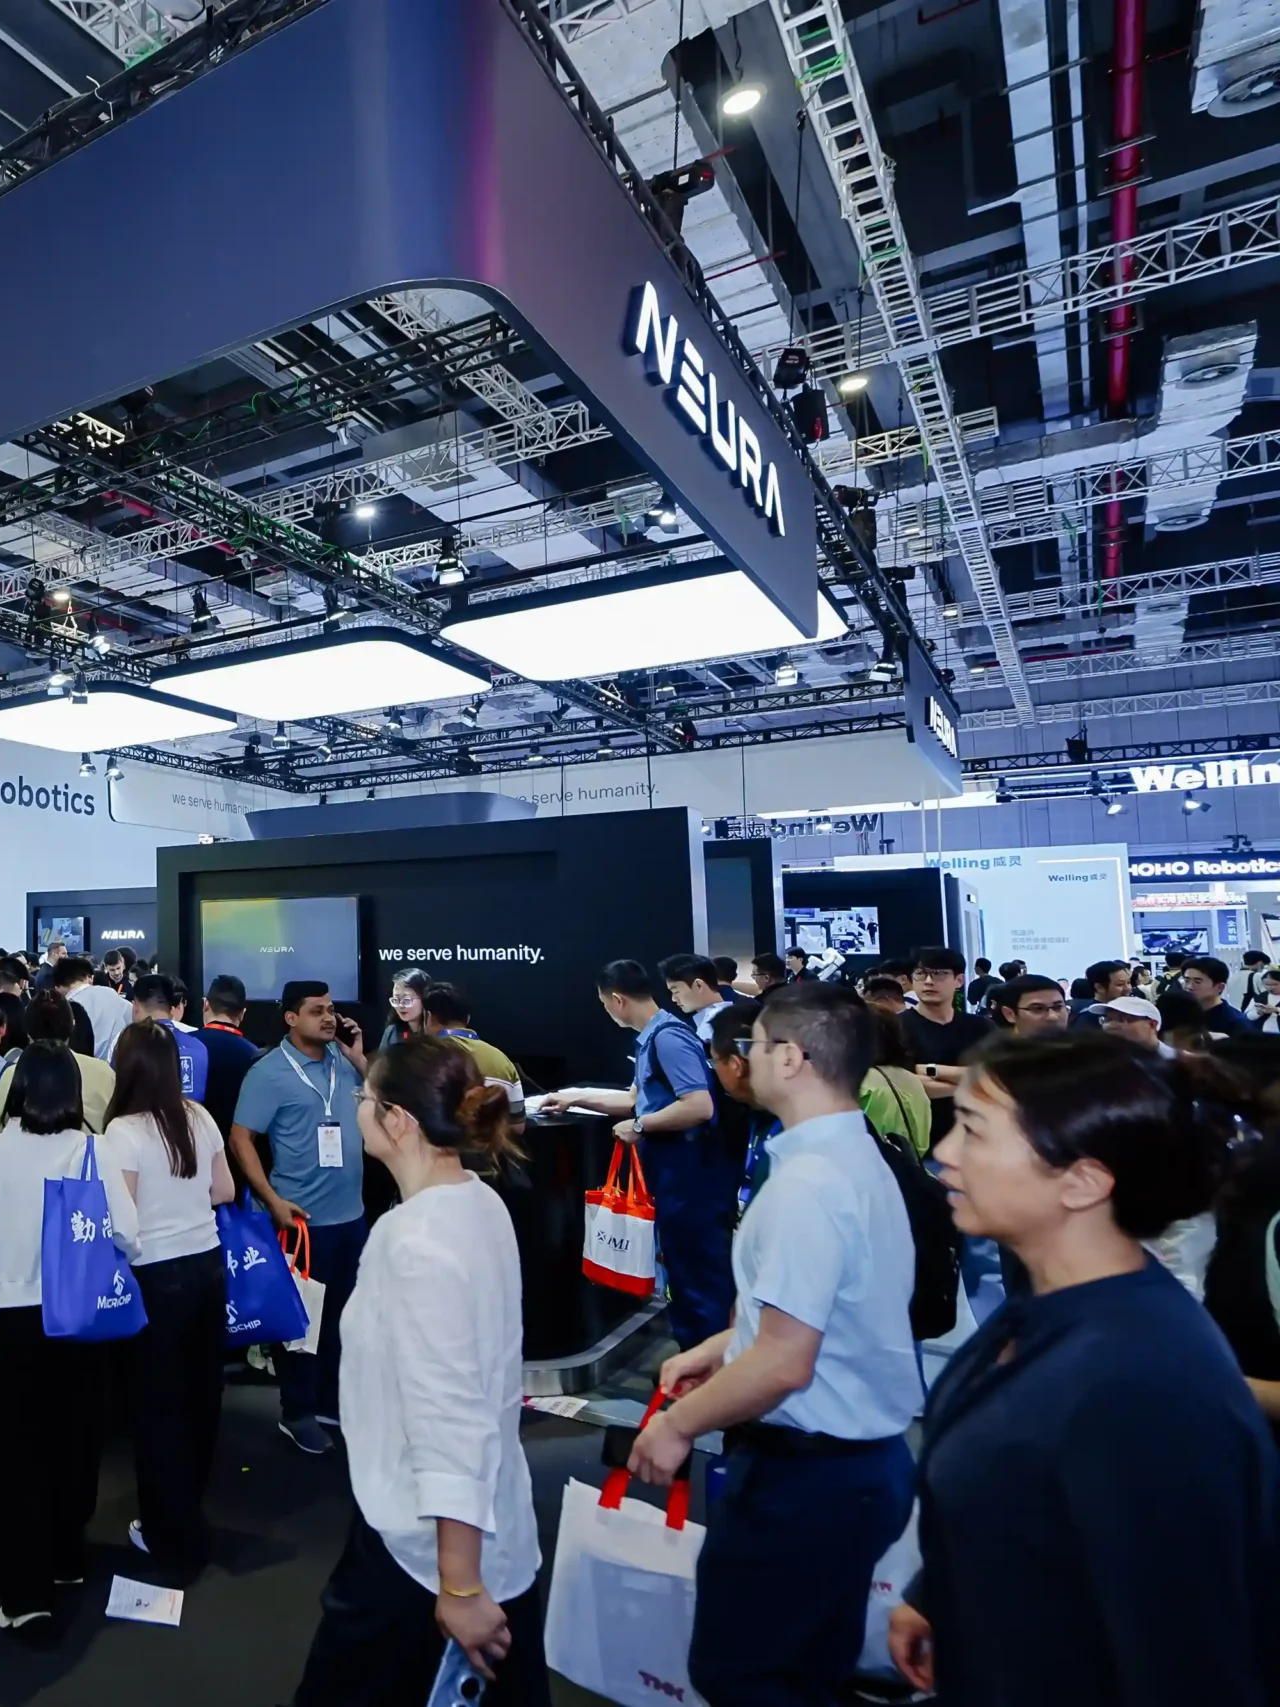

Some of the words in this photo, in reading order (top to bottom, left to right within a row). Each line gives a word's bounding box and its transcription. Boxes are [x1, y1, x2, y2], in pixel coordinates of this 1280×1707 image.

[635, 280, 786, 537] NEURA
[171, 793, 186, 804] we
[189, 796, 212, 810] serve
[531, 791, 573, 805] serve
[578, 781, 659, 801] humanity.
[1193, 858, 1280, 876] Robotic
[1048, 873, 1089, 882] Welling
[101, 929, 145, 940] NEURA
[378, 948, 403, 961] we
[406, 948, 452, 961] serve
[456, 943, 545, 965] humanity.
